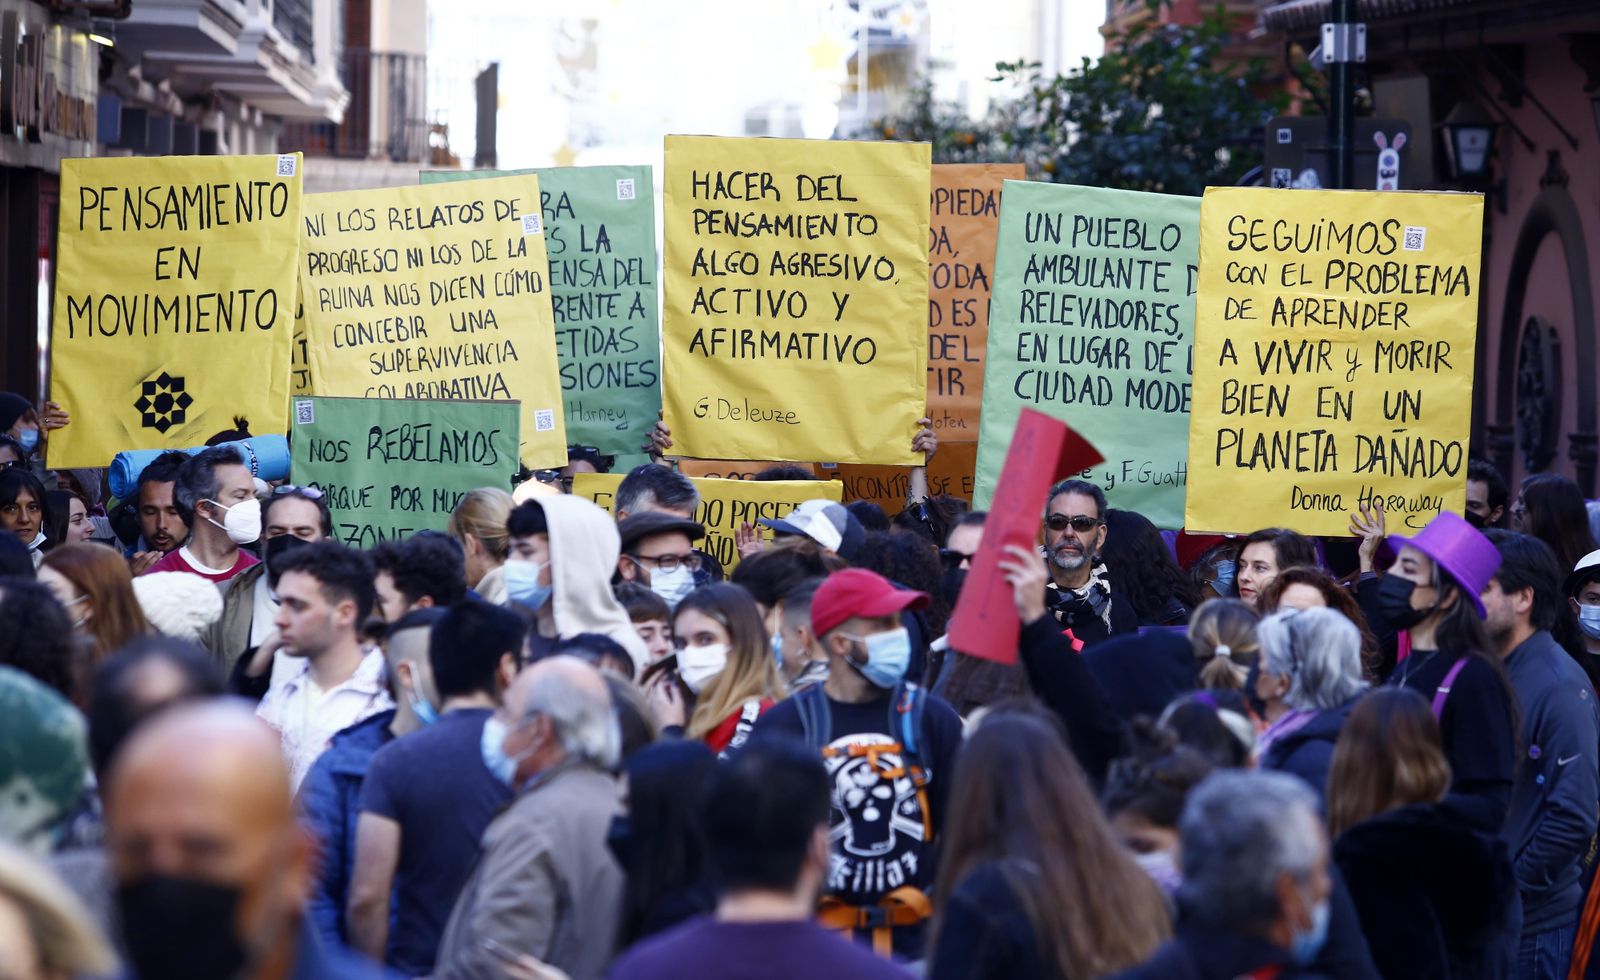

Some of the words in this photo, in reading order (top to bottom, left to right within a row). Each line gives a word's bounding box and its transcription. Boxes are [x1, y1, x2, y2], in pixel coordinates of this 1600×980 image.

[692, 170, 781, 202] HACER
[795, 174, 858, 202] DEL
[930, 187, 1003, 218] PIEDA
[79, 181, 288, 231] PENSAMIENTO
[305, 213, 325, 237] NI
[337, 208, 376, 233] LOS
[389, 200, 484, 231] RELATOS
[494, 198, 521, 222] DE
[692, 208, 878, 240] PENSAMIENTO
[580, 223, 612, 254] LA
[1025, 212, 1063, 245] UN
[1072, 214, 1182, 252] PUEBLO
[155, 246, 201, 281] EN
[308, 248, 398, 276] PROGRESO
[406, 247, 424, 269] NI
[430, 244, 462, 266] LOS
[472, 238, 497, 263] DE
[508, 236, 528, 258] LA
[549, 257, 607, 288] ENSA
[614, 256, 652, 290] DEL
[691, 247, 759, 277] ALGO
[769, 250, 900, 286] AGRESIVO,
[1023, 253, 1172, 293] AMBULANTE
[320, 284, 374, 312] RUINA
[384, 282, 420, 307] NOS
[430, 275, 485, 306] DICEN
[929, 262, 989, 291] ODA
[1226, 261, 1267, 286] CON
[1281, 262, 1313, 287] EL
[1325, 258, 1470, 297] PROBLEMA
[67, 288, 277, 339] MOVIMIENTO
[628, 291, 646, 320] A
[690, 286, 808, 319] ACTIVO
[832, 290, 850, 321] Y
[952, 298, 977, 327] ES
[1020, 289, 1184, 341] RELEVADORES,
[1224, 297, 1258, 321] DE
[1271, 296, 1411, 331] APRENDER
[333, 315, 428, 348] CONCEBIR
[449, 308, 499, 334] UNA
[369, 340, 519, 376] SUPERVIVENCIA
[689, 328, 876, 366] AFIRMATIVO
[929, 333, 980, 362] DEL
[1017, 332, 1049, 363] EN
[1058, 334, 1131, 370] LUGAR
[1144, 341, 1179, 376] DE
[1219, 338, 1239, 367] A
[1254, 338, 1333, 376] VIVIR
[1374, 339, 1453, 373] MORIR
[559, 359, 658, 392] SIONES
[1014, 369, 1113, 407] CIUDAD
[570, 400, 629, 431] Harney
[693, 397, 711, 421] G.
[717, 397, 801, 425] Deleuze
[1221, 378, 1291, 418] BIEN
[1316, 385, 1354, 422] EN
[1383, 389, 1422, 423] UN
[309, 439, 350, 463] NOS
[367, 422, 501, 466] REBELAMOS
[1215, 428, 1338, 473] PLANETA
[1352, 428, 1463, 478] DAÑADO
[390, 484, 424, 512] POR
[1290, 485, 1348, 513] Donna
